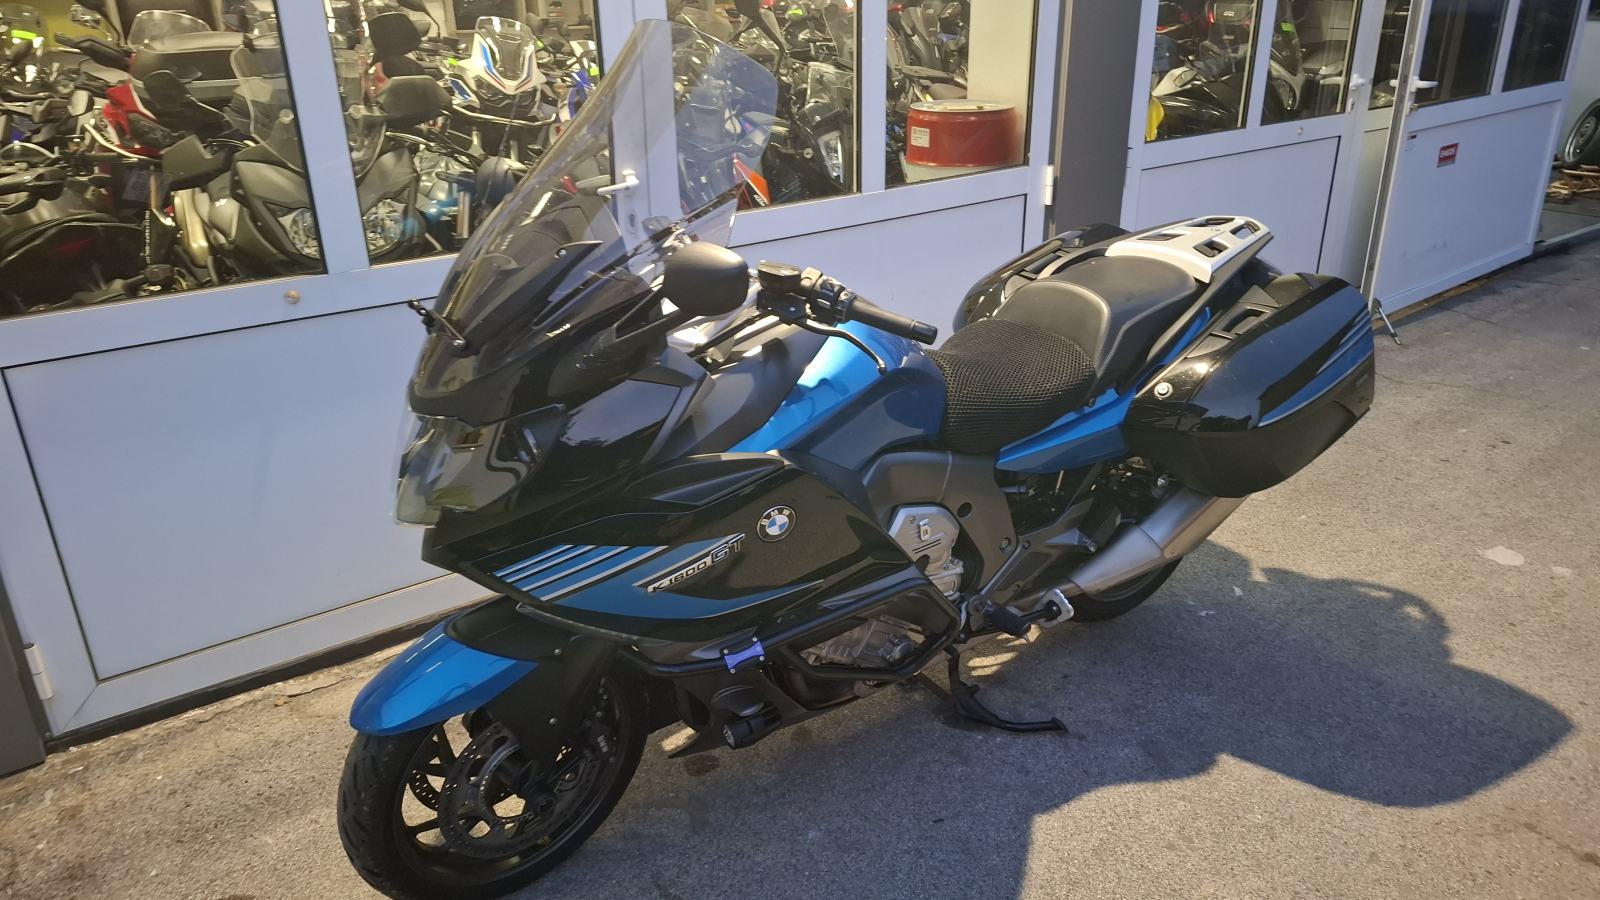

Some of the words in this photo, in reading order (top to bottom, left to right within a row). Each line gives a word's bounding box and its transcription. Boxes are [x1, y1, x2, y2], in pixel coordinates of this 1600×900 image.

[760, 508, 792, 526] BMW
[653, 583, 665, 593] K
[669, 561, 707, 585] 1600
[711, 533, 746, 564] GT
[597, 735, 609, 753] BMW
